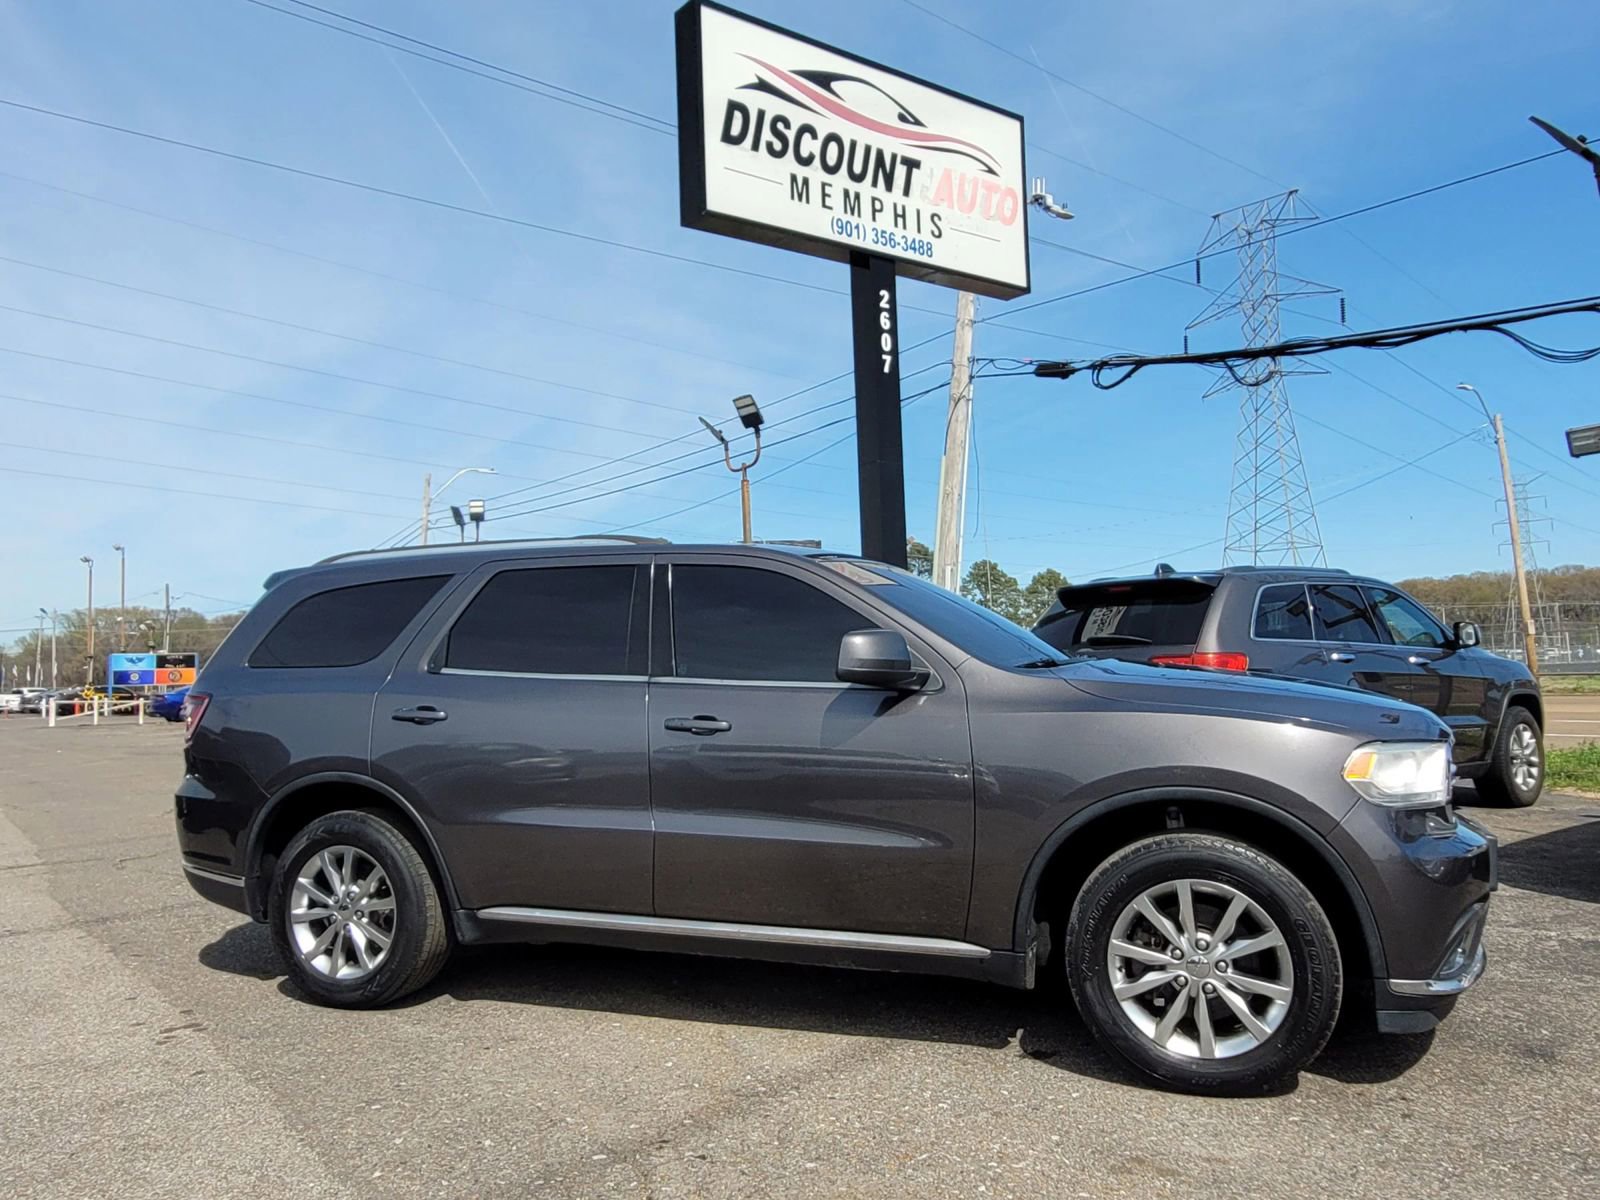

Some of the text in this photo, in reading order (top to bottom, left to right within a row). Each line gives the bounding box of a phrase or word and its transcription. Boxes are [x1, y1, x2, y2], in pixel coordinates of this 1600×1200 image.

[720, 98, 1018, 226] DISCOUNT AUTO
[789, 172, 942, 239] MEMPHIS
[831, 216, 933, 258] (901) 356-3488
[879, 289, 892, 374] 2607
